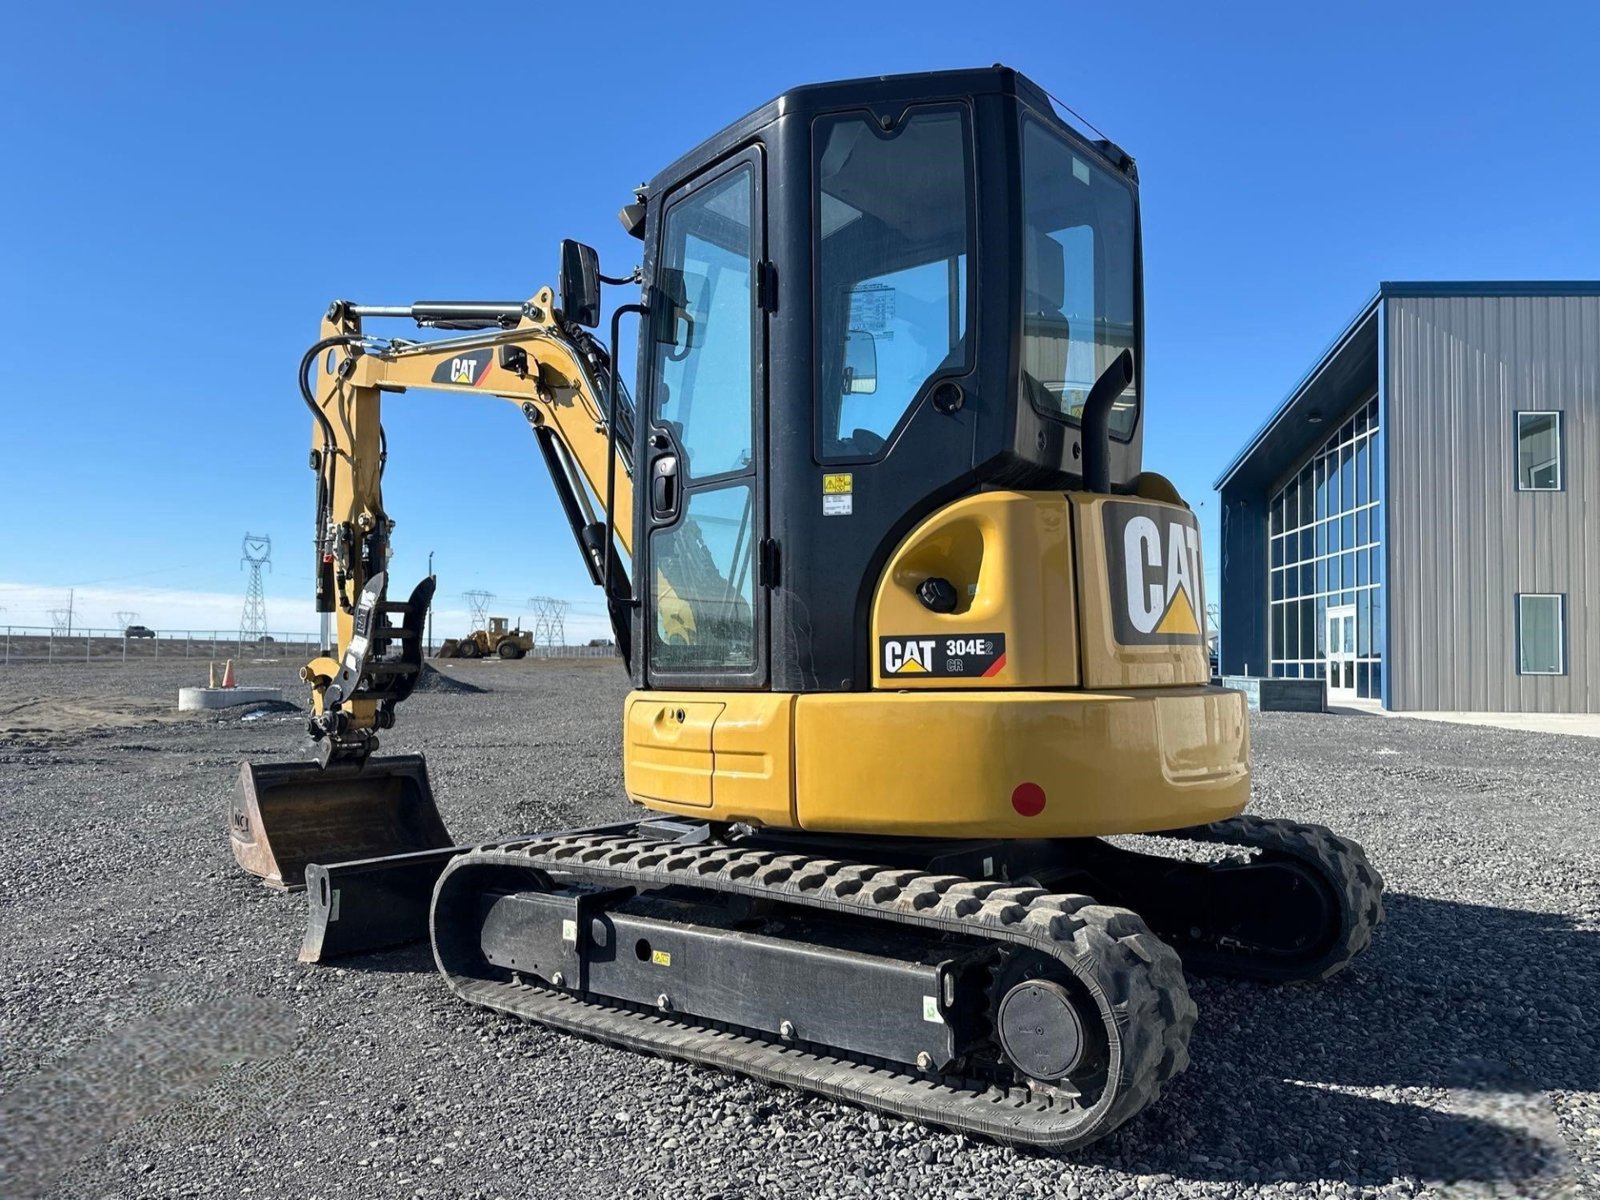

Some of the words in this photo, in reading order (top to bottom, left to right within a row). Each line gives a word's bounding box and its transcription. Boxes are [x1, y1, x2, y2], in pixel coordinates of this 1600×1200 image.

[451, 358, 477, 383] CAT
[1124, 515, 1202, 634] CAT
[885, 640, 936, 673] CAT
[946, 658, 963, 672] CR
